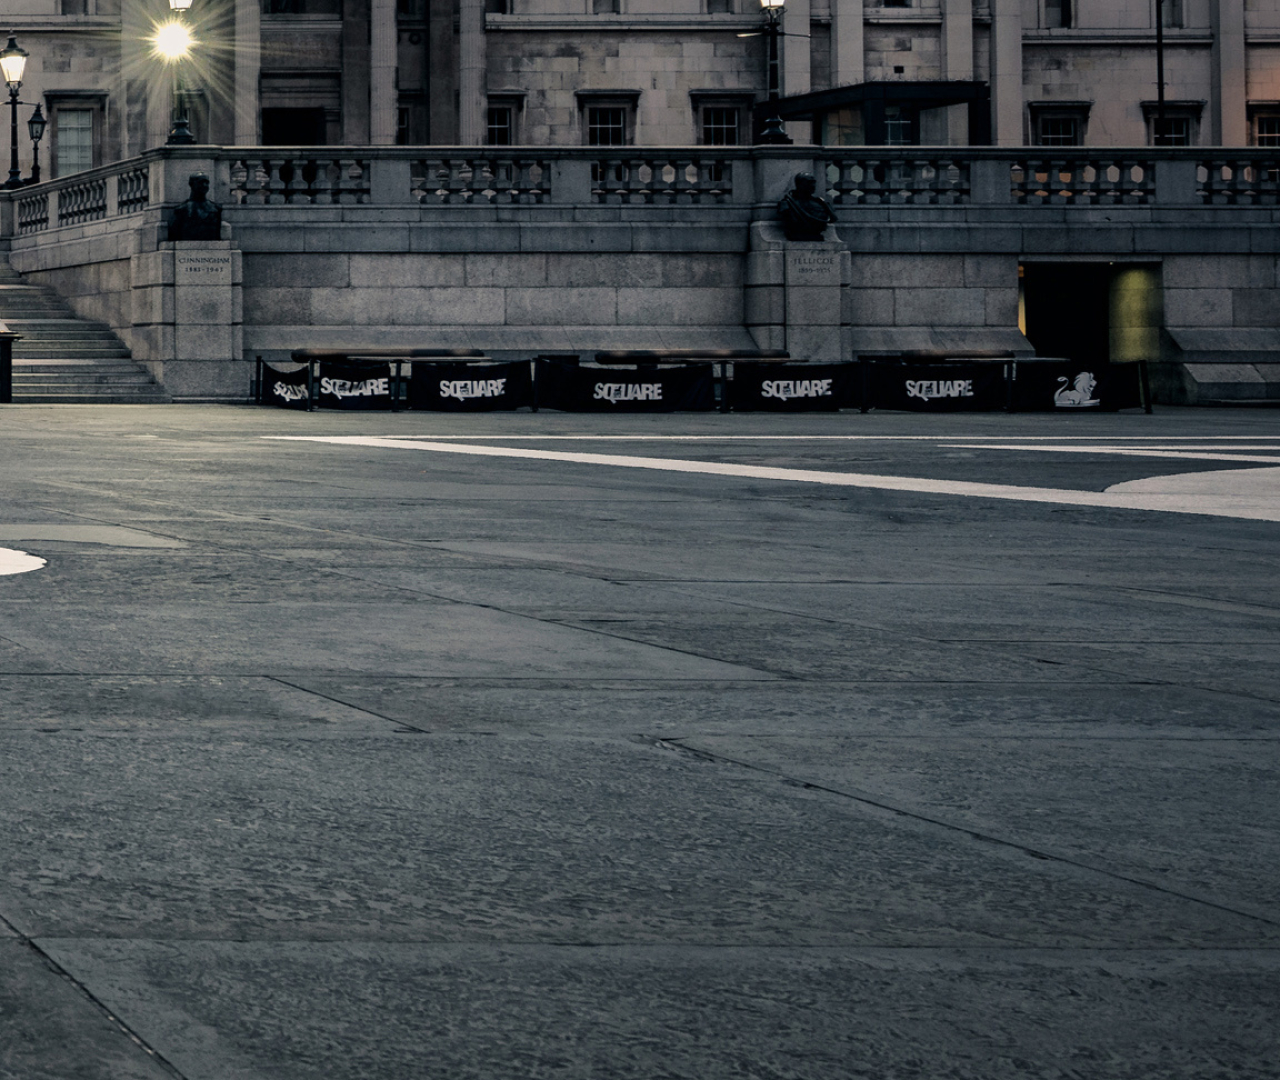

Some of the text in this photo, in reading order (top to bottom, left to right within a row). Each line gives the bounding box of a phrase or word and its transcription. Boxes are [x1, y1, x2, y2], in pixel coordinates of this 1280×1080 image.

[793, 257, 835, 265] JELLICOE
[320, 377, 390, 400] SQUARE
[439, 378, 507, 402] SQUARE
[592, 382, 663, 404] SQUARE
[761, 378, 833, 402] SQUARE
[905, 379, 975, 402] SQUARE
